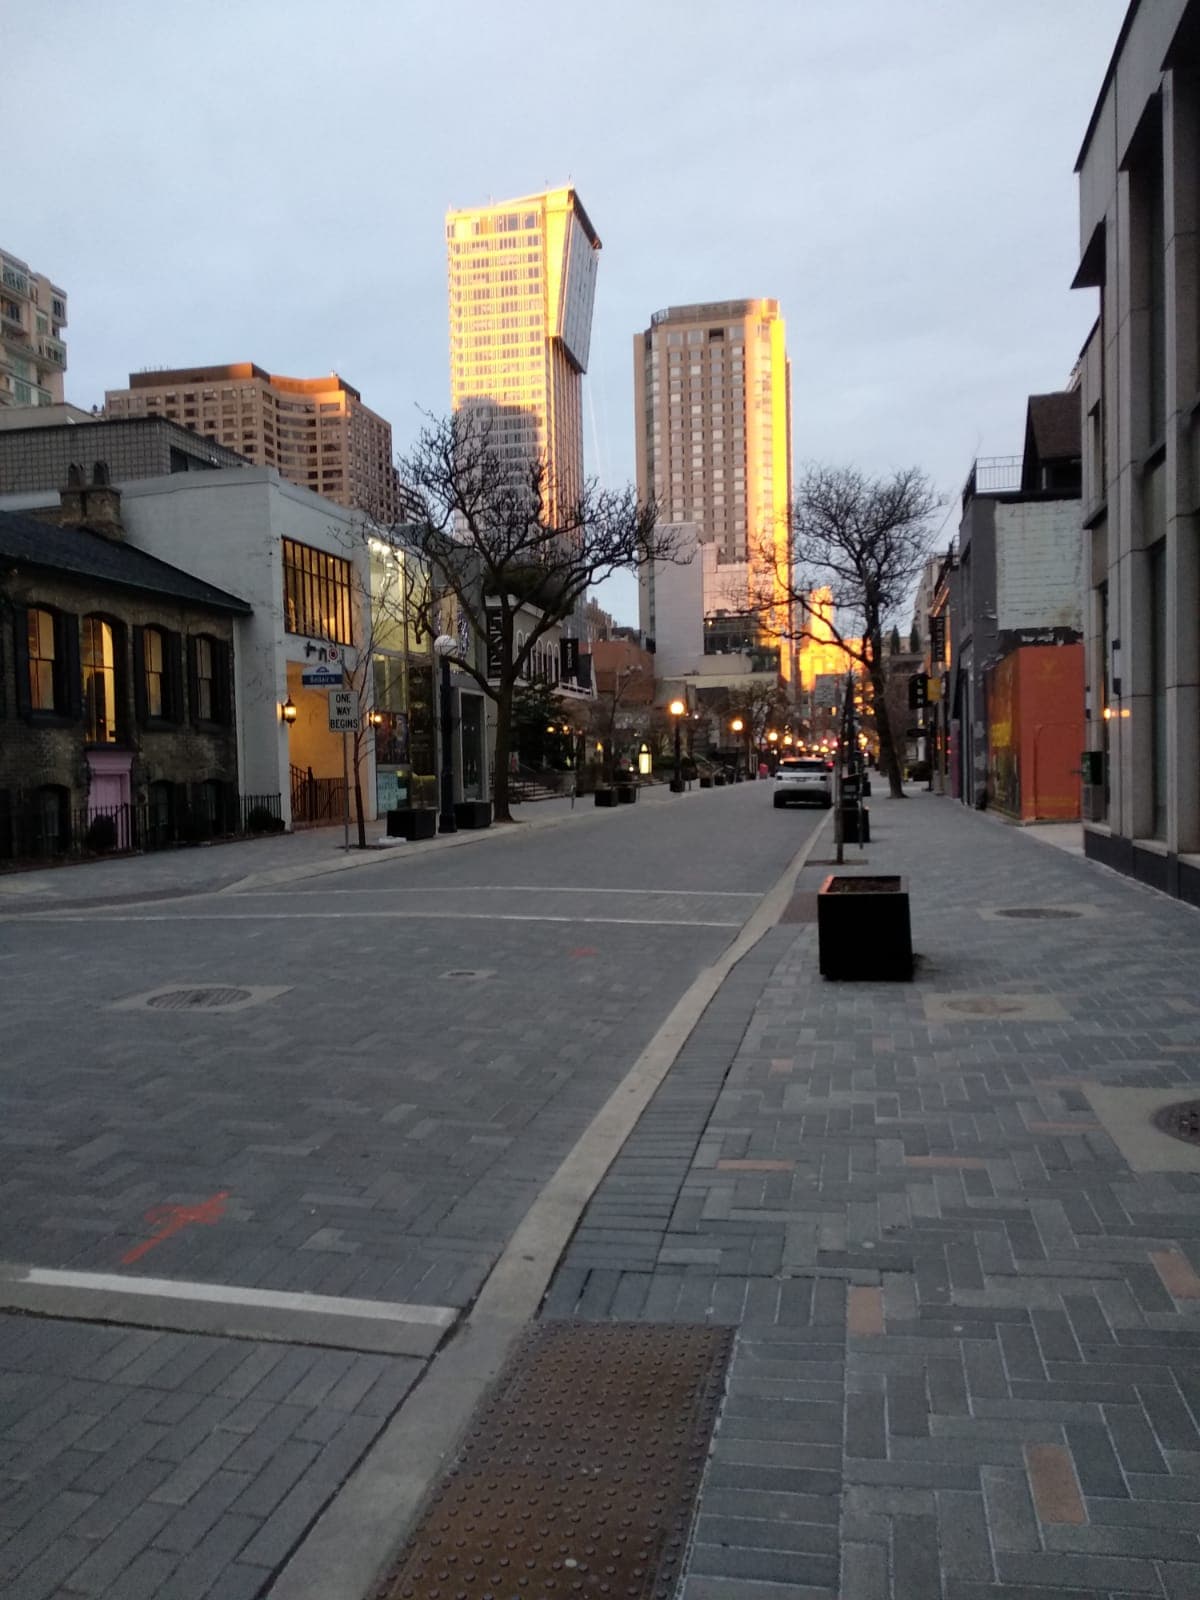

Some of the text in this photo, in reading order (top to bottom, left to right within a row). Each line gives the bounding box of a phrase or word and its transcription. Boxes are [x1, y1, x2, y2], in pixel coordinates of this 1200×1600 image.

[335, 693, 351, 703] ONE
[336, 706, 352, 716] WAY
[330, 719, 359, 729] BEGINS
